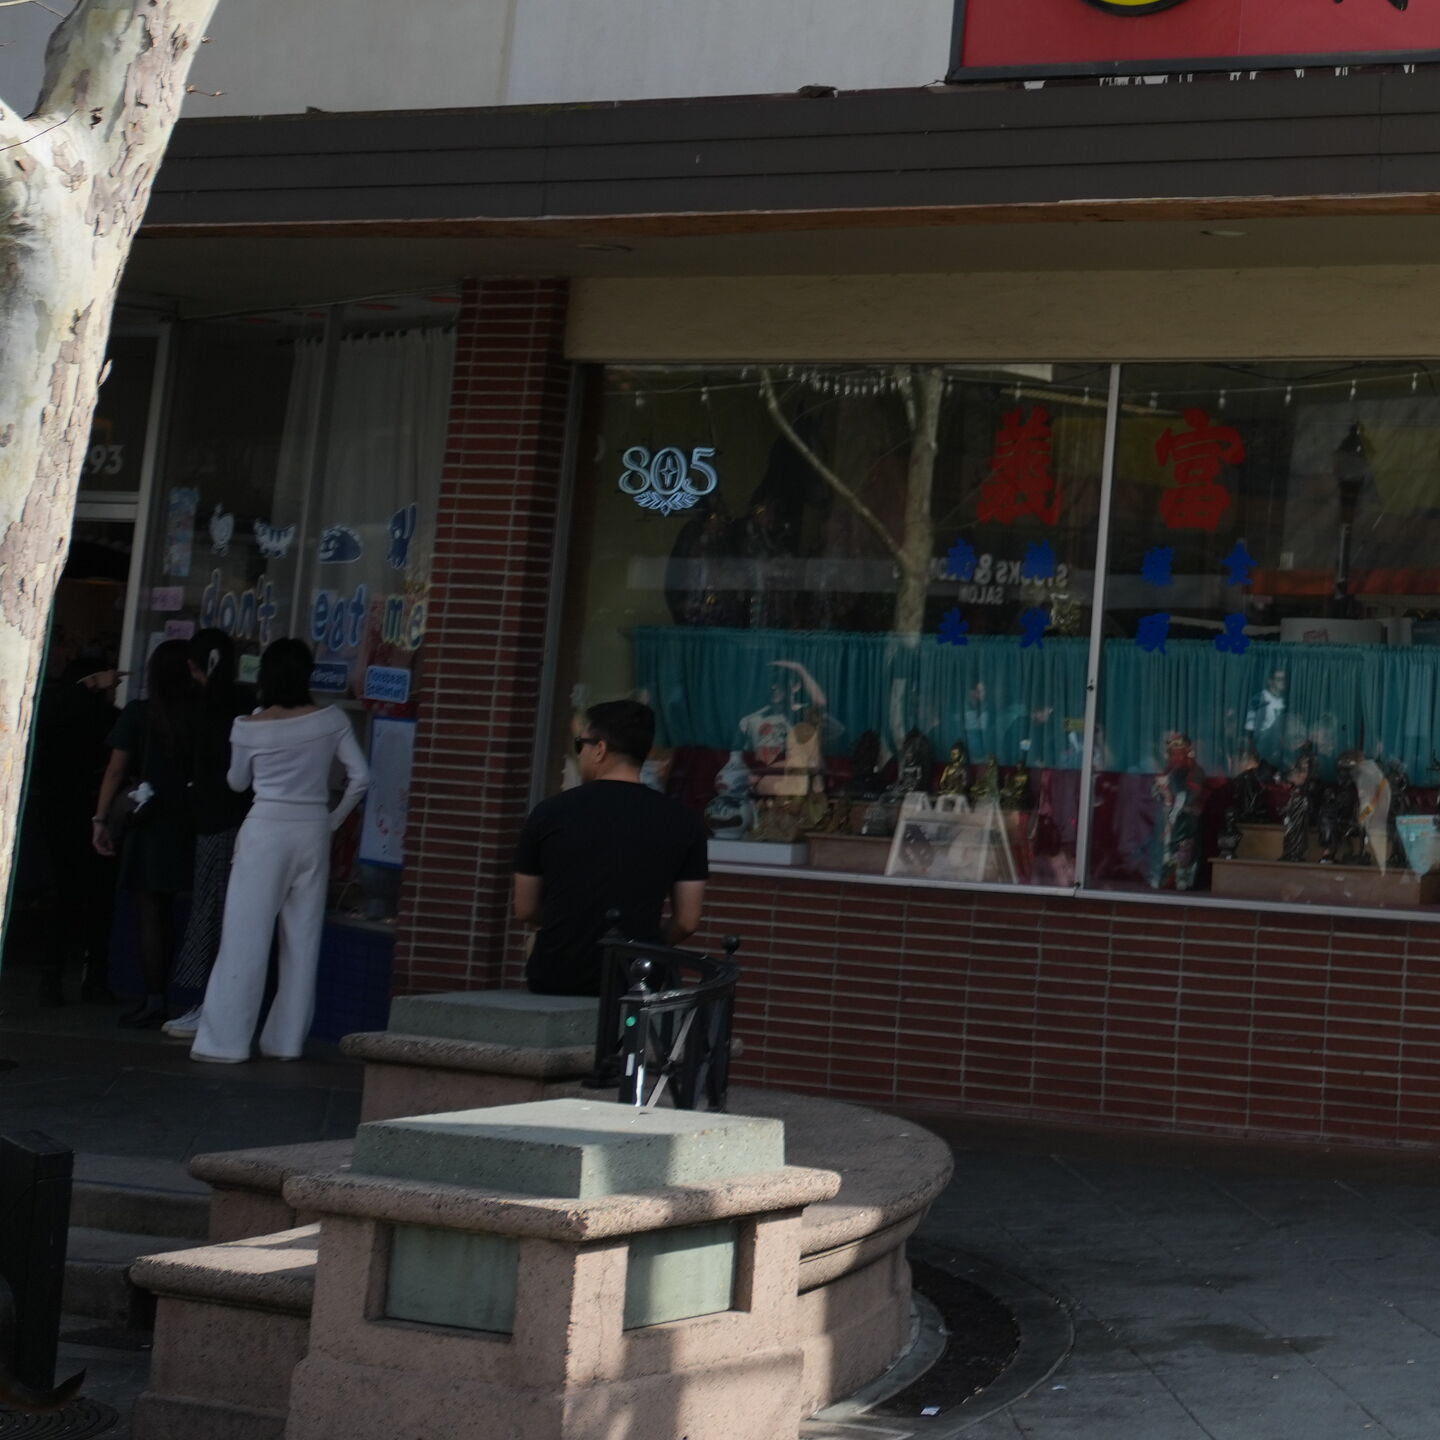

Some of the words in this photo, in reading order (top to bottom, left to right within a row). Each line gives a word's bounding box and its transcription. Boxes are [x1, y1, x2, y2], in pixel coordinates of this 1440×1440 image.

[618, 446, 718, 496] 805
[312, 584, 367, 651] eat
[382, 594, 427, 651] me
